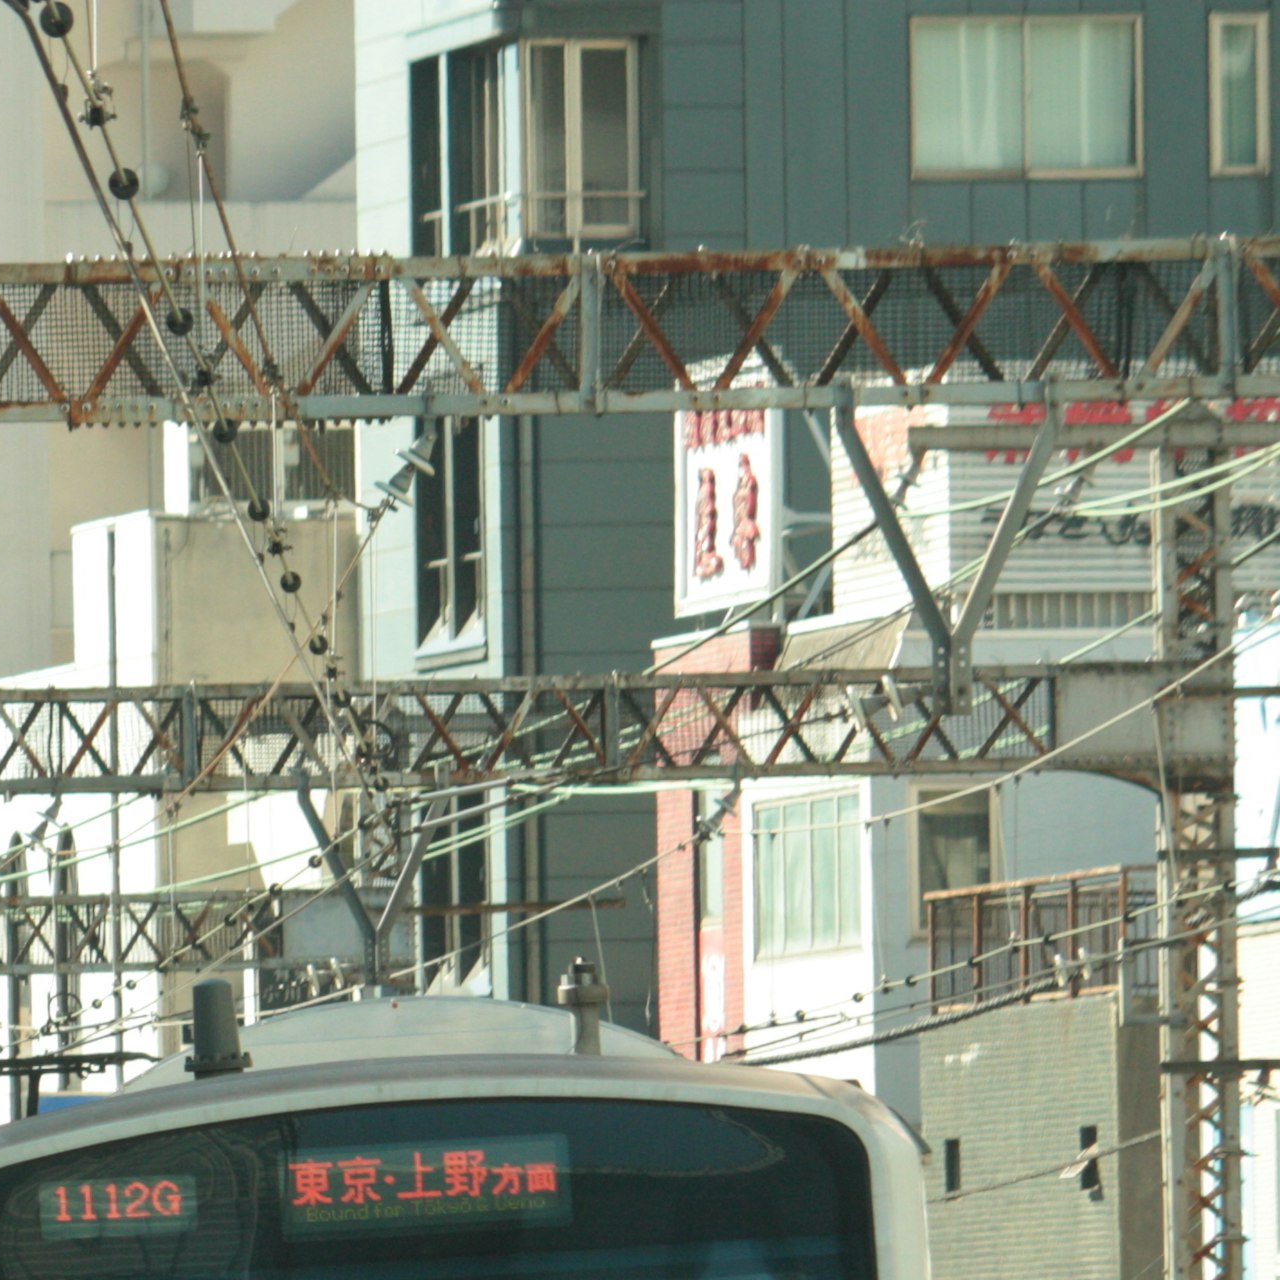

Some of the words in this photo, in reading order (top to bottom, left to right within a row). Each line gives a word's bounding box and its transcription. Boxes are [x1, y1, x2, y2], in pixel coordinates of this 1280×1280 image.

[54, 1180, 183, 1222] 1112G
[305, 1205, 369, 1222] Bound
[374, 1203, 403, 1219] for
[495, 1195, 547, 1211] Ueno
